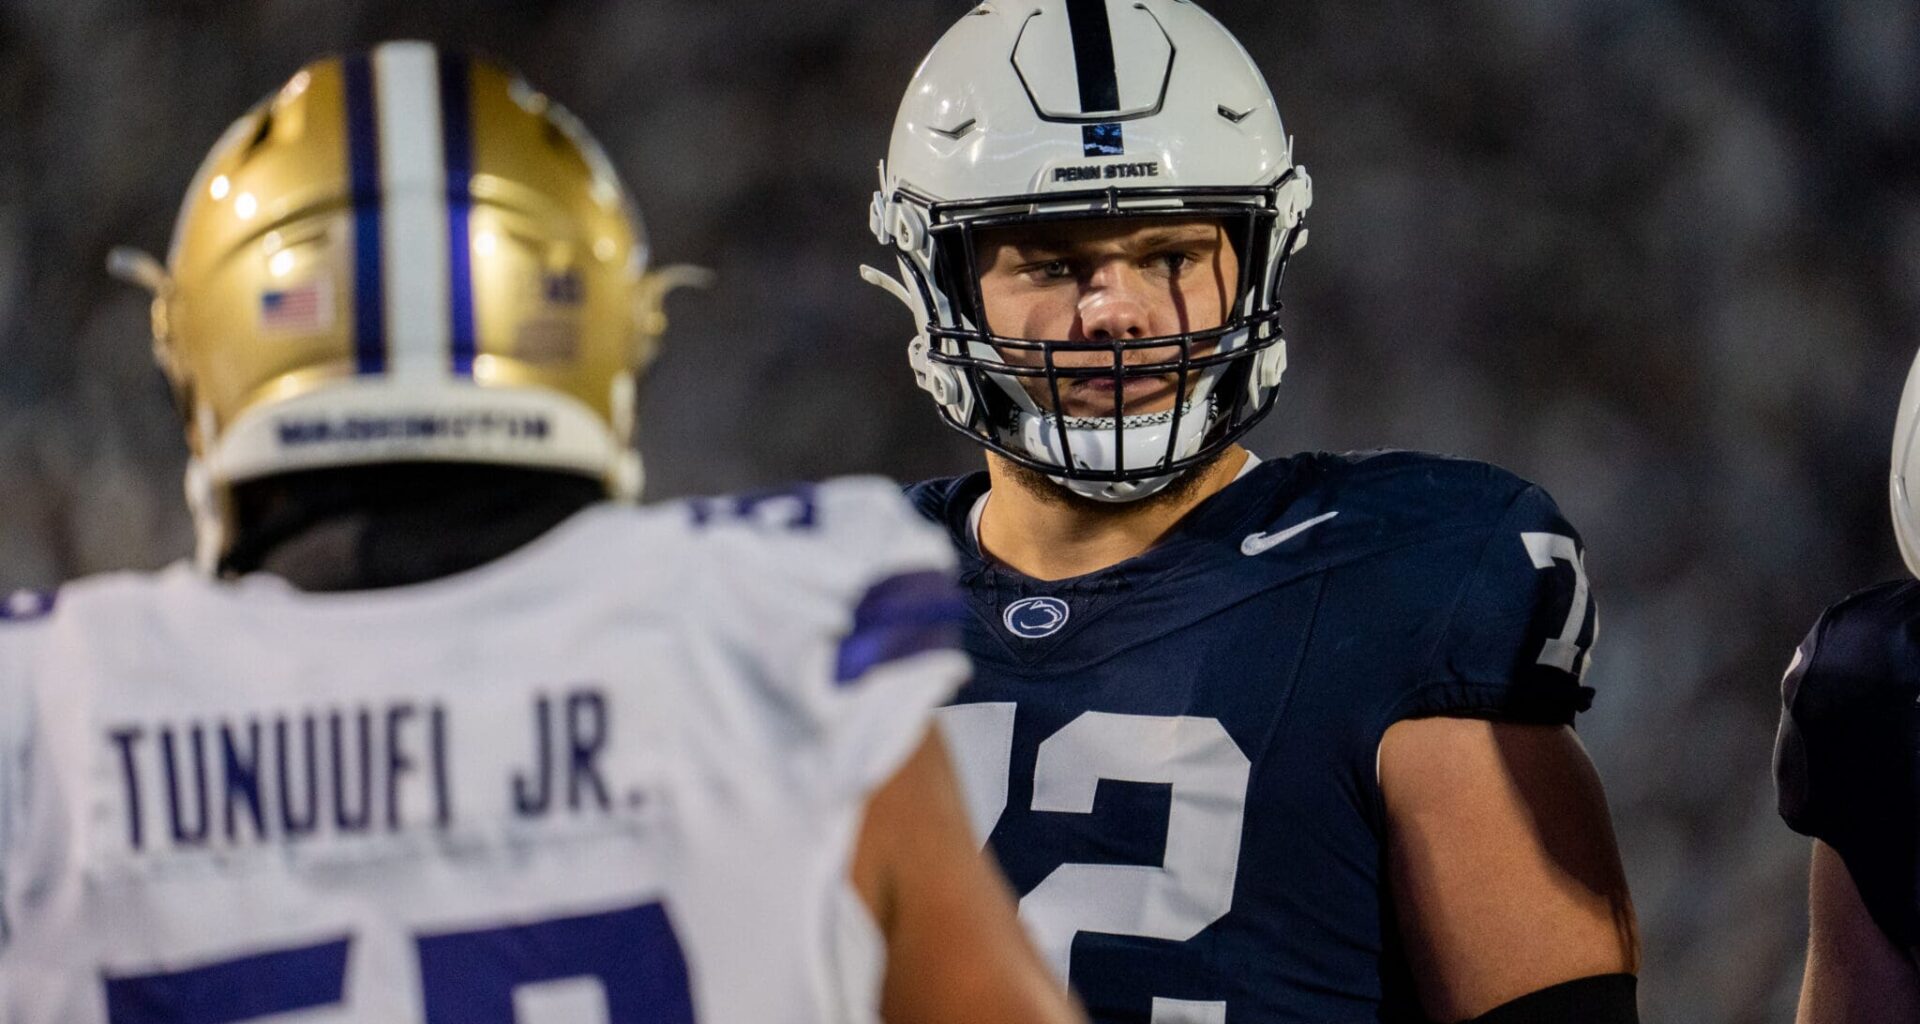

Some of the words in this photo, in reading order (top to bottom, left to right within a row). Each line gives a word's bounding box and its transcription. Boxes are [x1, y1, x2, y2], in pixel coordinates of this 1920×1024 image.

[1053, 166, 1101, 182] PENN
[1104, 162, 1159, 179] STATE
[107, 699, 451, 851] TUNUUFI
[512, 688, 643, 820] JR.
